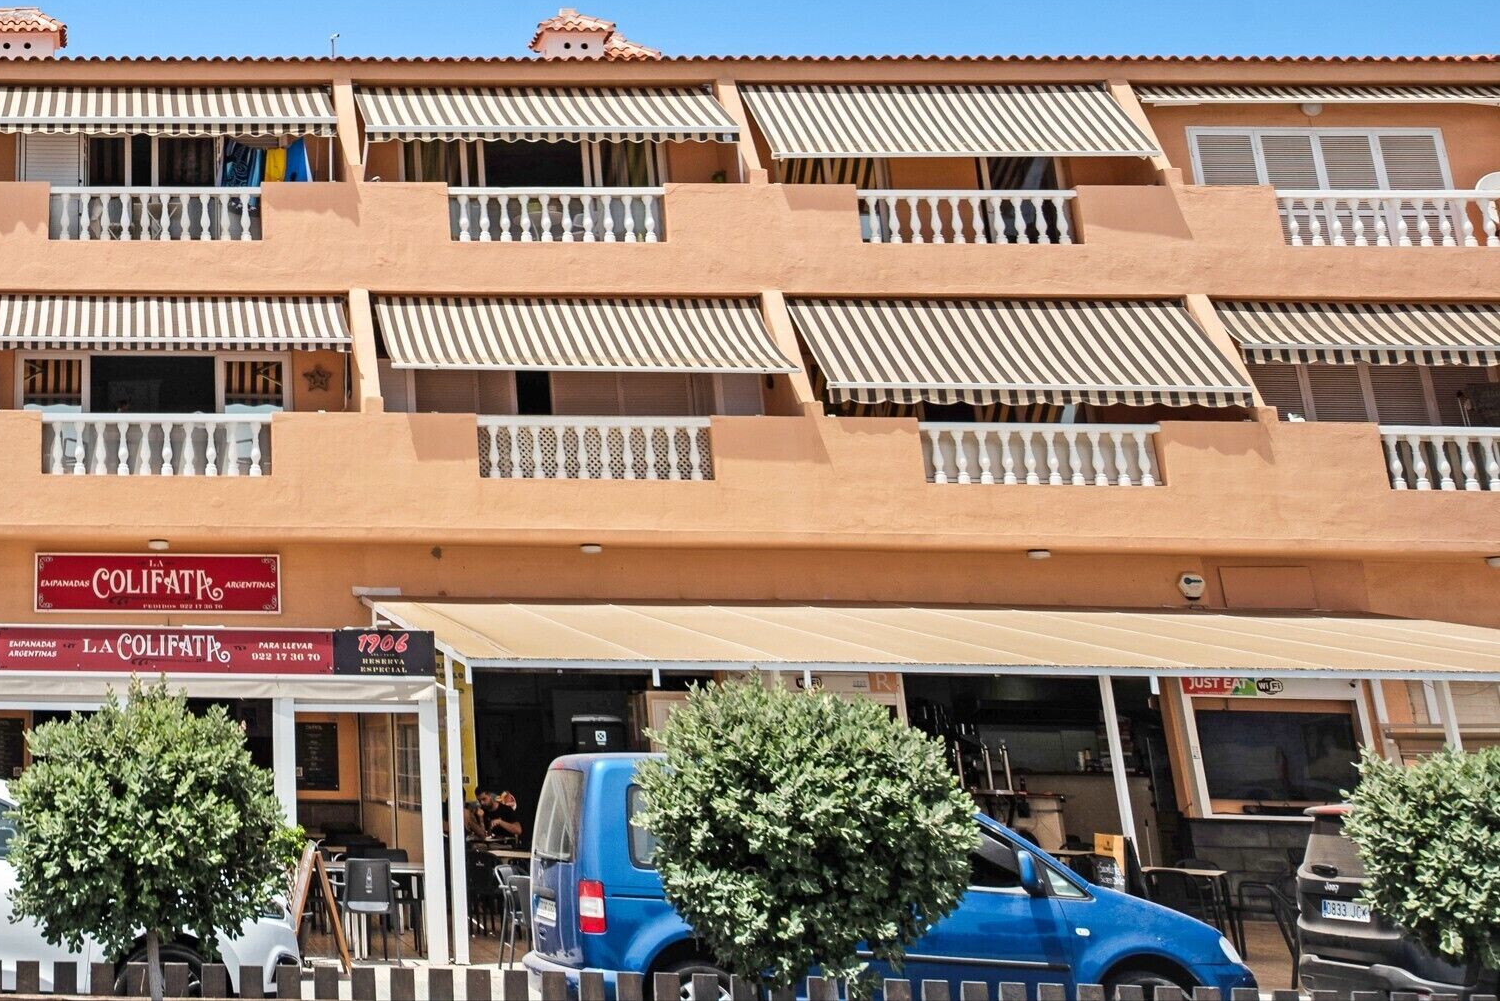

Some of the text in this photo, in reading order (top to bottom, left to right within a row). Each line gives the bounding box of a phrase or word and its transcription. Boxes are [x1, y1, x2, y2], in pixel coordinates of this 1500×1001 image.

[149, 559, 164, 568] LA
[41, 579, 90, 588] EMPANADAS
[92, 567, 224, 601] COLIFATA
[225, 581, 276, 590] ARGENTINAS
[9, 640, 56, 648] EMPANADAS
[283, 642, 313, 650] LLEVAR
[358, 632, 410, 653] 1906
[82, 633, 231, 662] LA COLIFATA
[8, 650, 57, 658] ARGENTINAS
[252, 652, 272, 661] 922
[277, 652, 287, 661] 17
[307, 653, 320, 662] 70
[362, 658, 405, 666] RESERVA
[1188, 677, 1247, 690] JUST EAT
